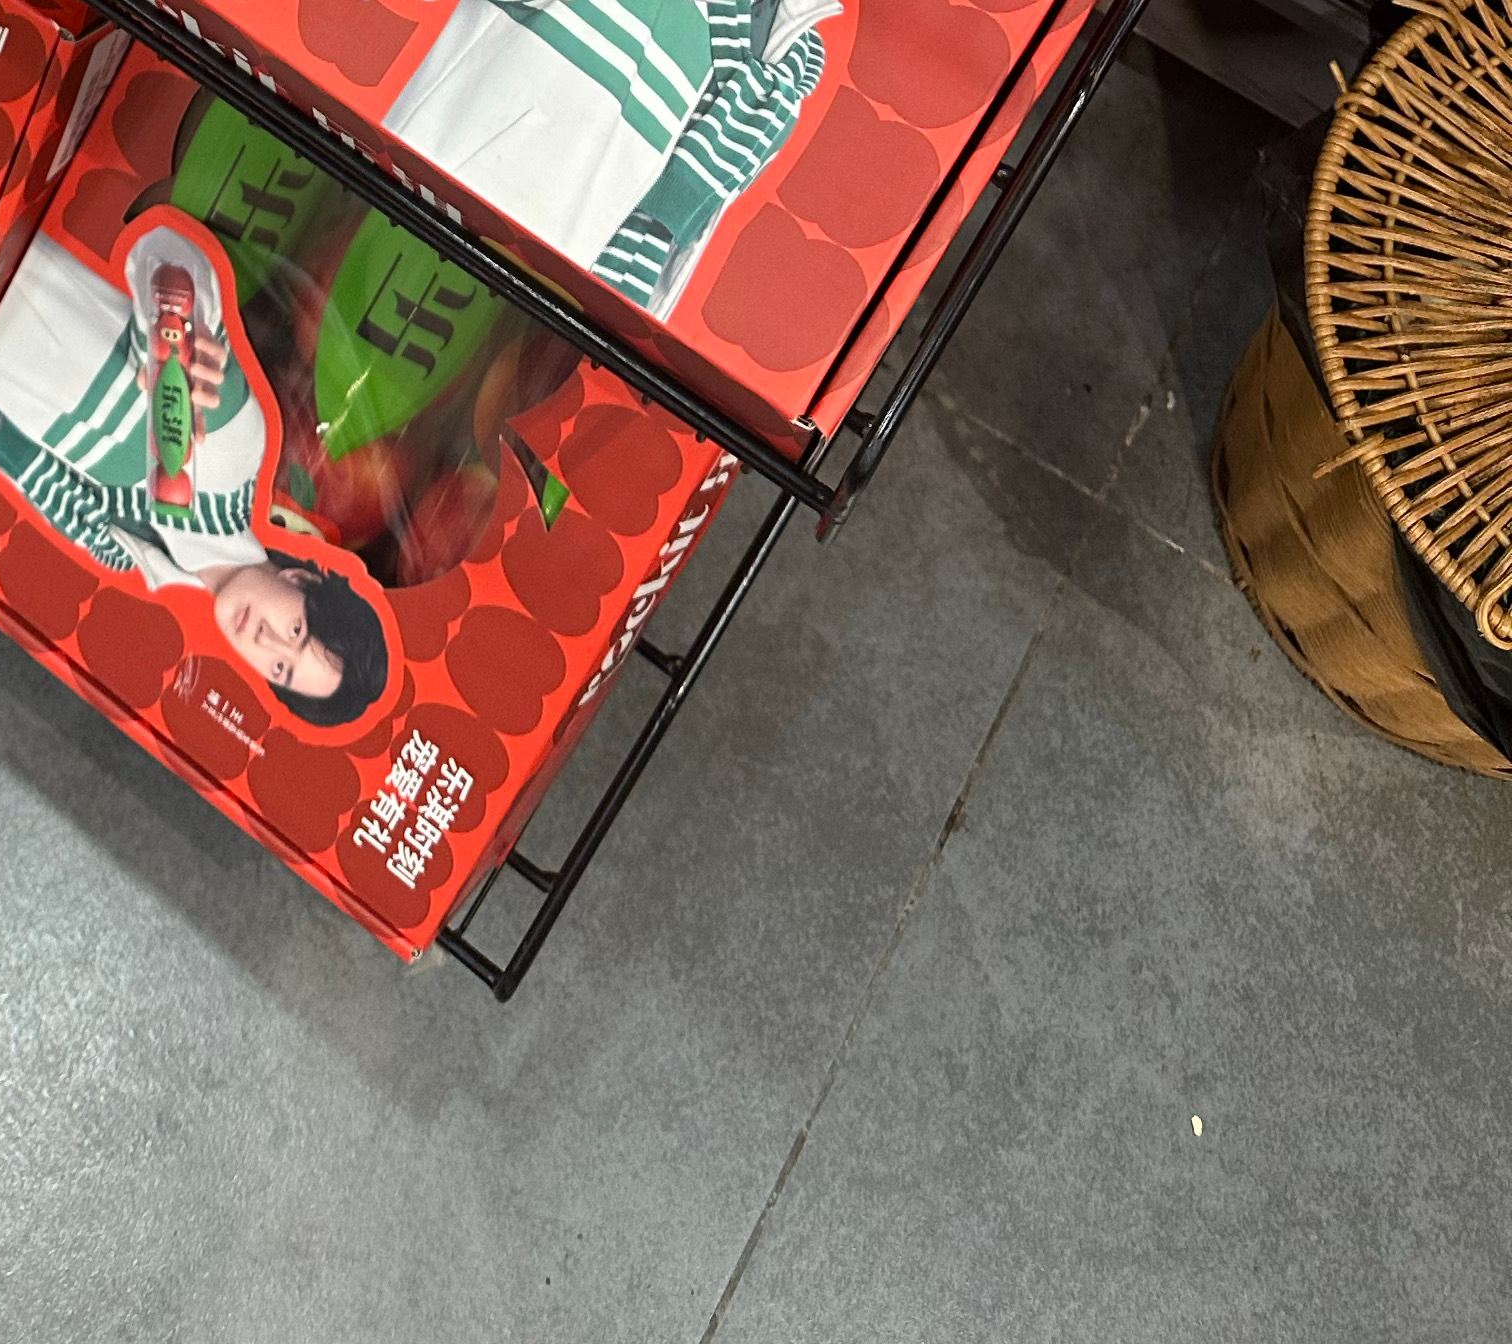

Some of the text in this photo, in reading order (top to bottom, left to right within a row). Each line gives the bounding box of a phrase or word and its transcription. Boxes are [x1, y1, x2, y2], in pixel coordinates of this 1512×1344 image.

[577, 504, 710, 709] rockit
[352, 729, 441, 854] 宠爱有礼
[385, 757, 476, 890] 乐淇时刻
